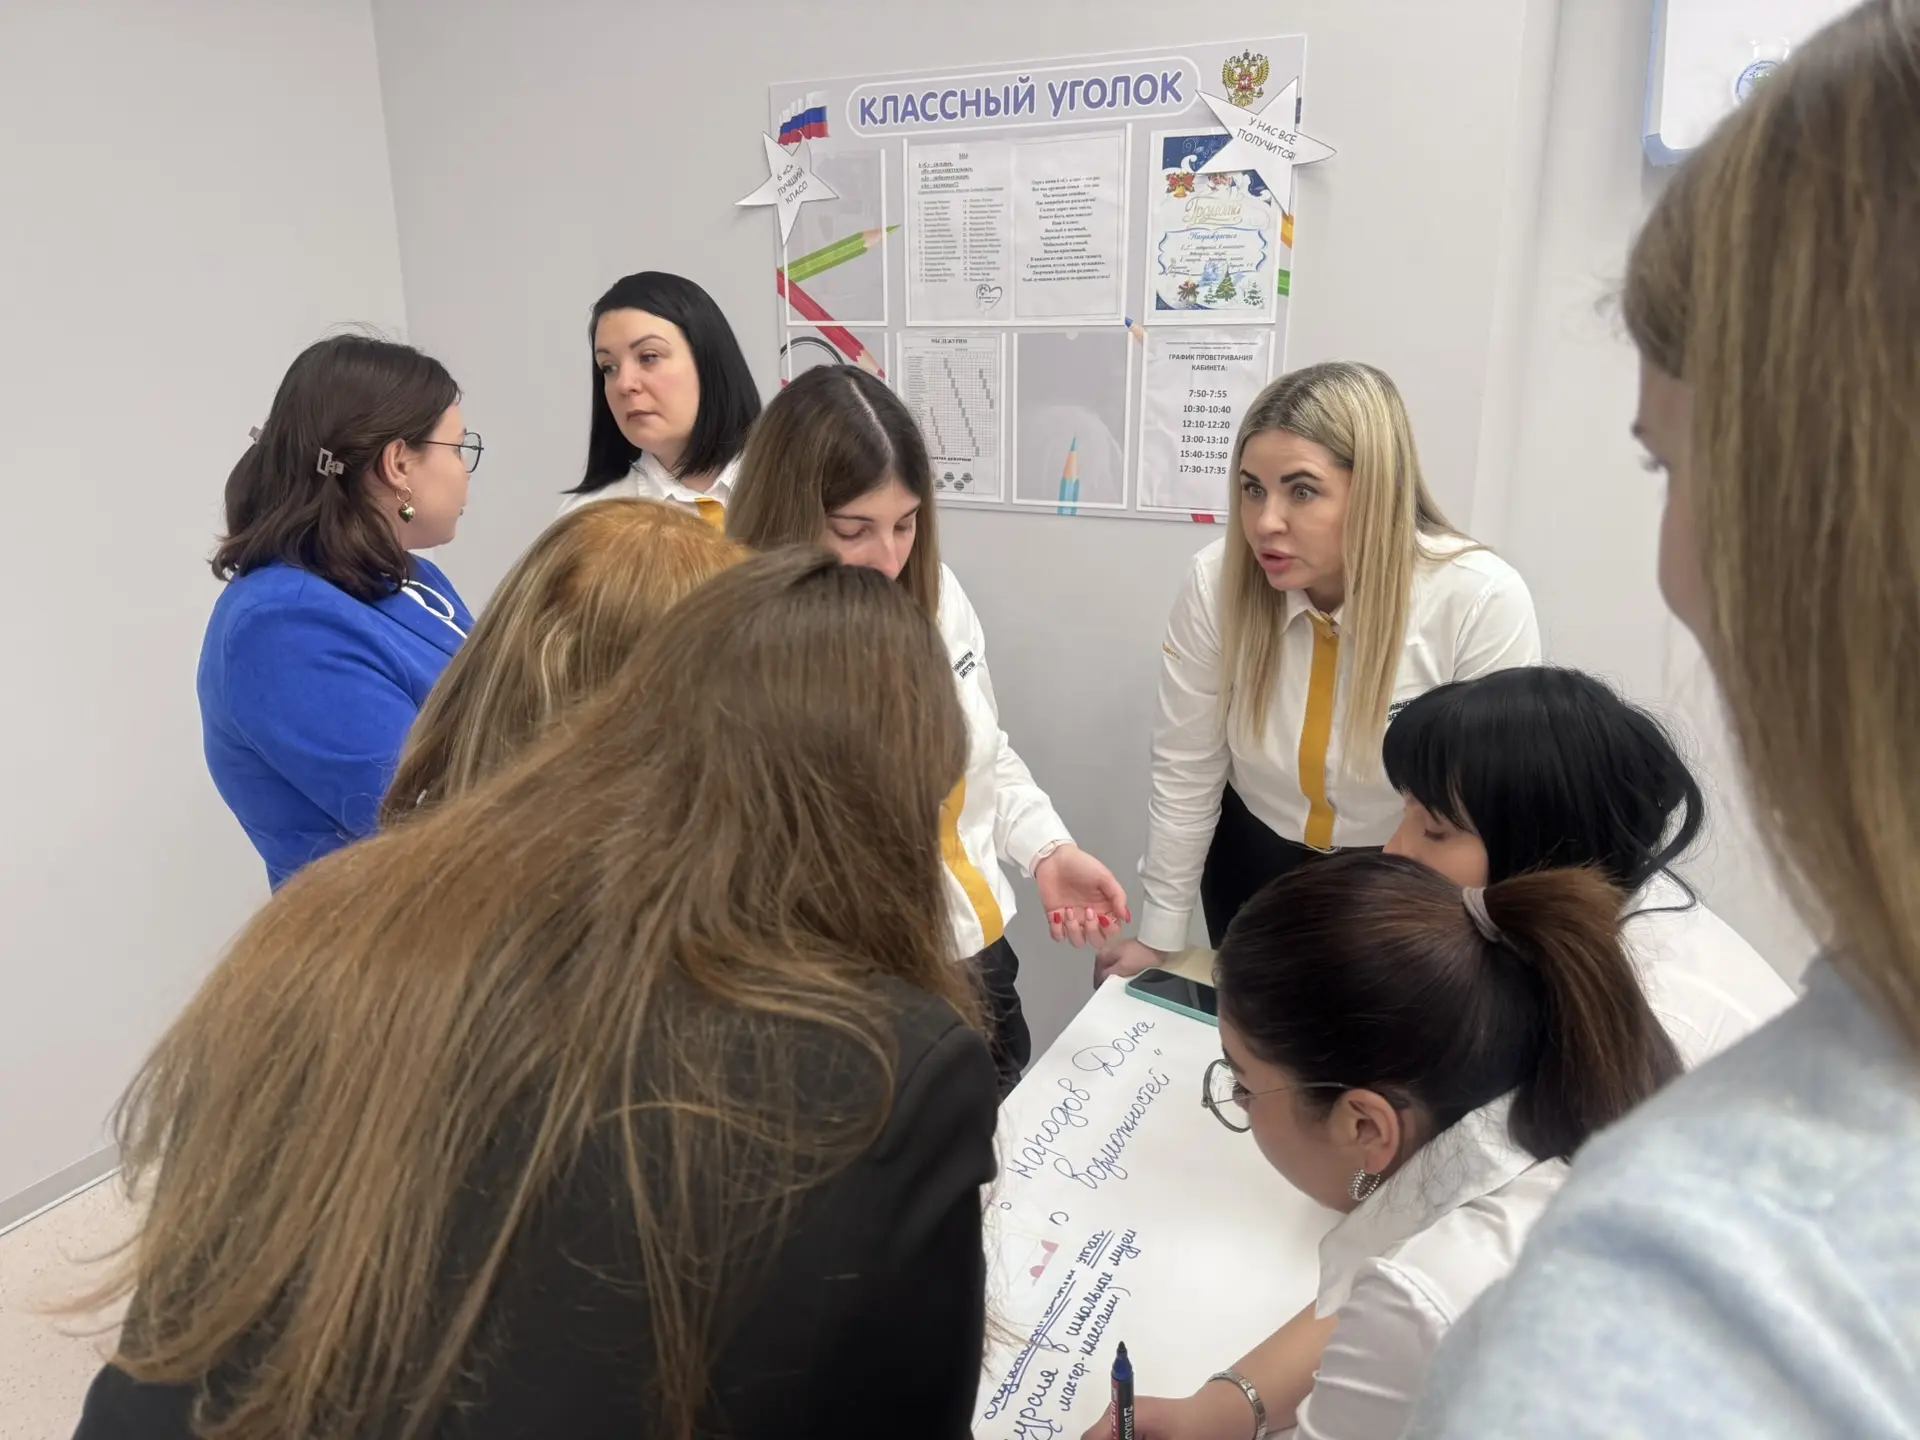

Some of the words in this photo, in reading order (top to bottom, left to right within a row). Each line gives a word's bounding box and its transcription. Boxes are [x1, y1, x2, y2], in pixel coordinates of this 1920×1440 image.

[860, 75, 1036, 127] КЛАССНЫЙ
[1048, 70, 1184, 117] УГОЛОК
[1248, 117, 1257, 126] У
[1257, 120, 1278, 136] НАС
[1237, 128, 1296, 161] ПОЛУЧИТСЯ!
[777, 173, 783, 181] 6
[777, 167, 805, 196] ЛУЧШИЙ
[1188, 389, 1228, 398] 7:50-7:55
[1183, 405, 1231, 414] 10:30-10:40
[1182, 420, 1230, 429] 12:10-12:20
[1181, 435, 1229, 444] 13:00-13:10
[1180, 450, 1228, 460] 15:40-15:50
[1179, 465, 1227, 475] 17:30-17:35
[1072, 1022, 1156, 1077] Дона
[1123, 1415, 1134, 1440] BRAU
